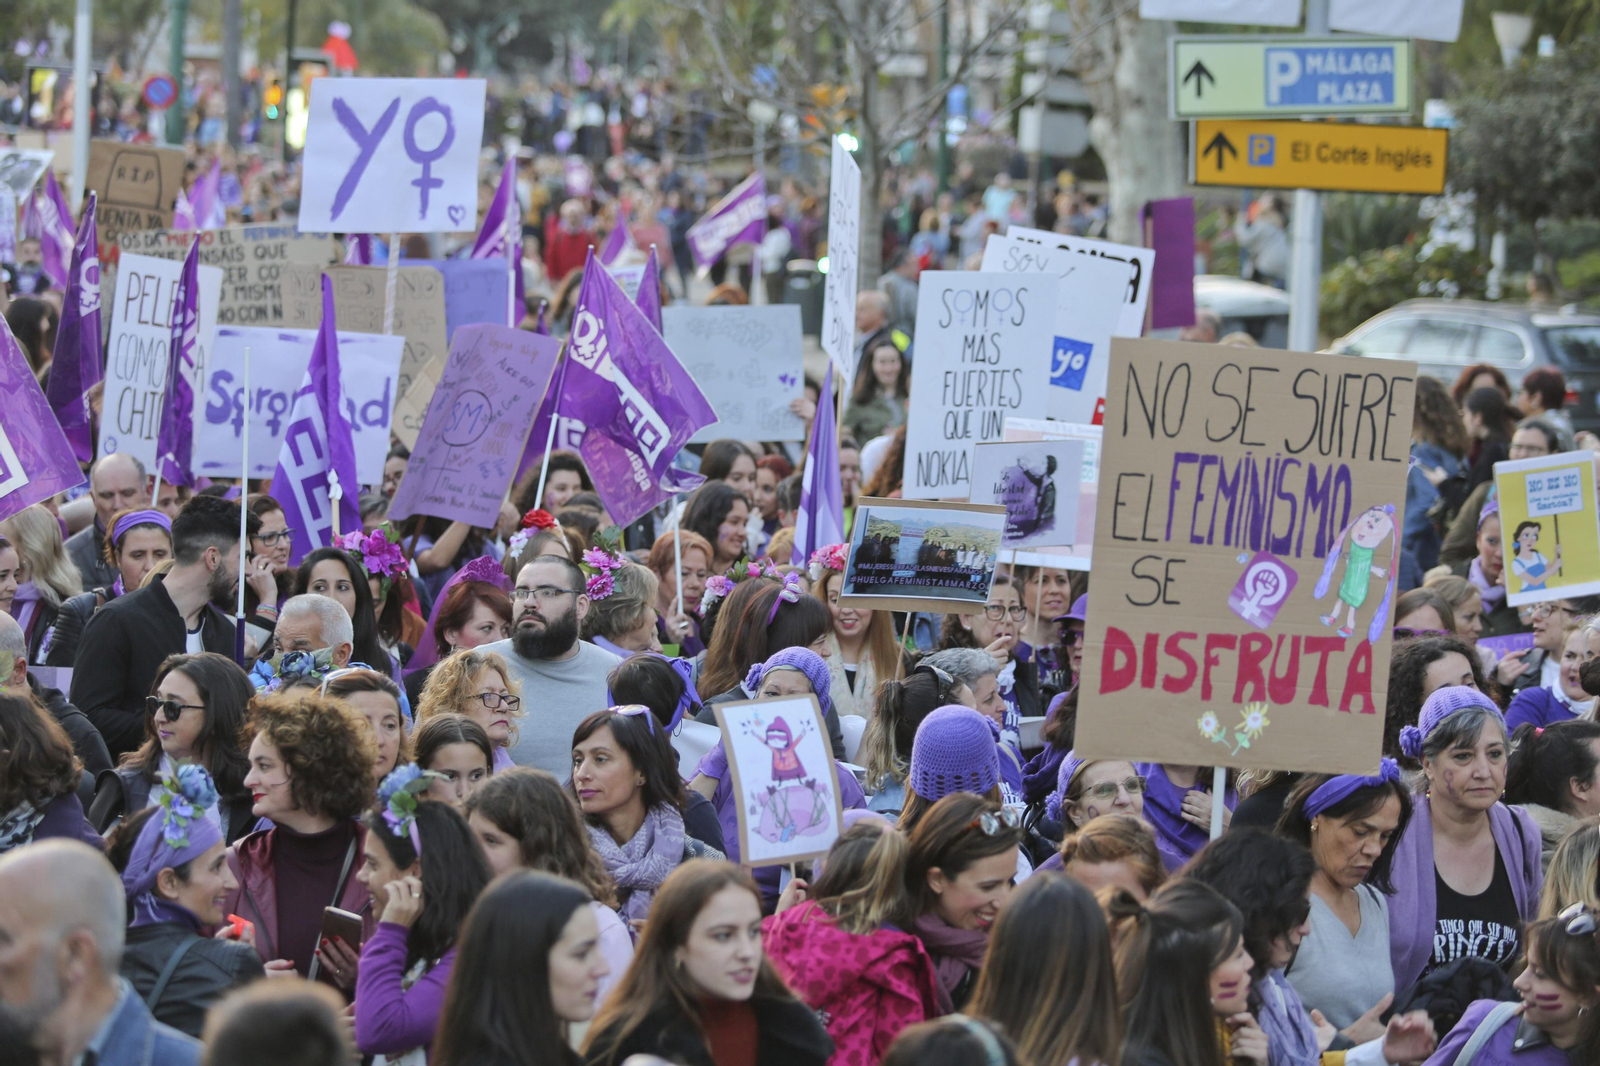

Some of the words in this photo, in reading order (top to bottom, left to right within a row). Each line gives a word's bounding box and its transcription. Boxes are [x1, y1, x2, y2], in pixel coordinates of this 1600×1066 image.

[1268, 50, 1301, 105] P
[1305, 49, 1394, 75] MÁLAGA
[1316, 79, 1385, 104] PLAZA
[1253, 138, 1271, 163] P
[1290, 141, 1310, 162] El
[1316, 142, 1369, 165] Corte
[1375, 145, 1434, 171] Inglés
[219, 229, 233, 246] EL
[253, 242, 288, 261] QUE
[124, 271, 200, 335] PELE
[238, 306, 268, 322] CON
[939, 287, 1029, 330] SOMOS
[115, 332, 168, 389] COMO
[1049, 347, 1086, 379] yo
[942, 368, 1023, 410] FUERTES
[943, 409, 975, 441] QUE
[980, 409, 1005, 441] UN
[1123, 361, 1192, 440] NO
[1205, 363, 1281, 447] SE
[1284, 368, 1414, 463] SUFRE
[916, 450, 970, 488] NOKIA
[1112, 472, 1159, 542] EL
[1125, 555, 1187, 607] SE
[1099, 626, 1377, 715] DISFRUTA
[1468, 919, 1483, 935] QUE
